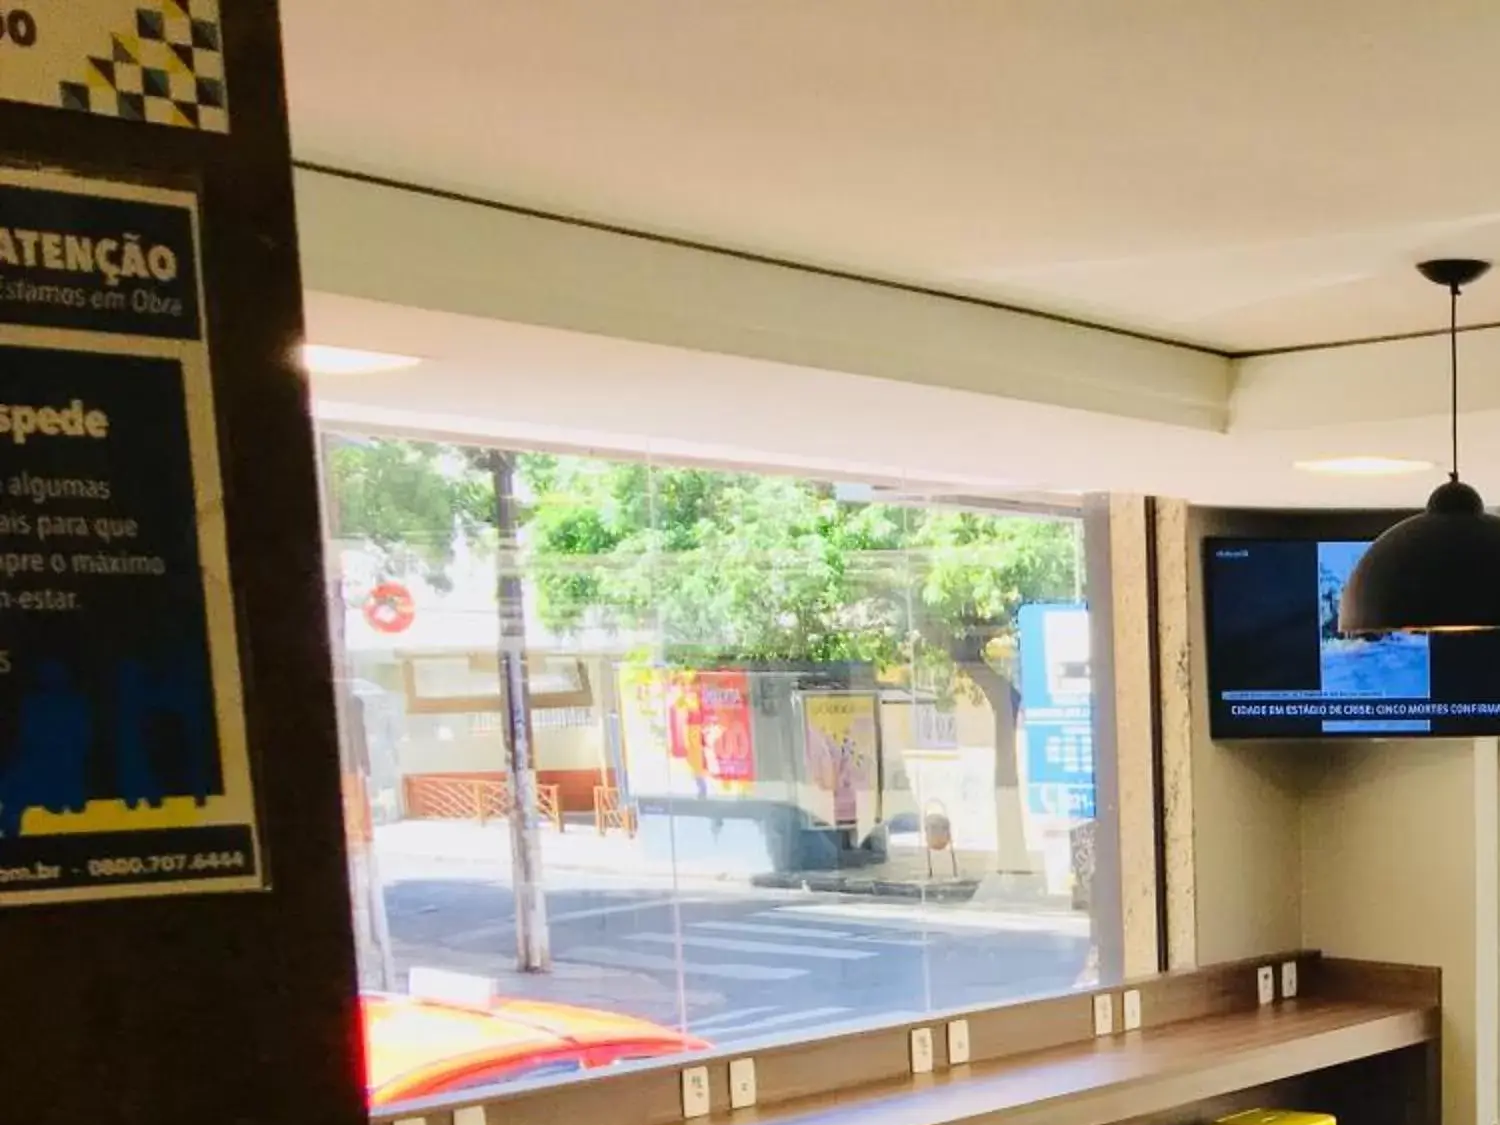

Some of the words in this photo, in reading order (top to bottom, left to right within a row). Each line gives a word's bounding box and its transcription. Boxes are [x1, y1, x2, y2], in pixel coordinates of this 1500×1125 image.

[0, 228, 177, 286] ATENÇÃO
[90, 288, 126, 310] em
[8, 470, 111, 503] algumas
[37, 514, 90, 541] para
[94, 516, 139, 544] que
[50, 553, 67, 574] o
[71, 548, 167, 576] máximo
[1376, 703, 1406, 715] CINCO
[1408, 703, 1449, 715] MORTES
